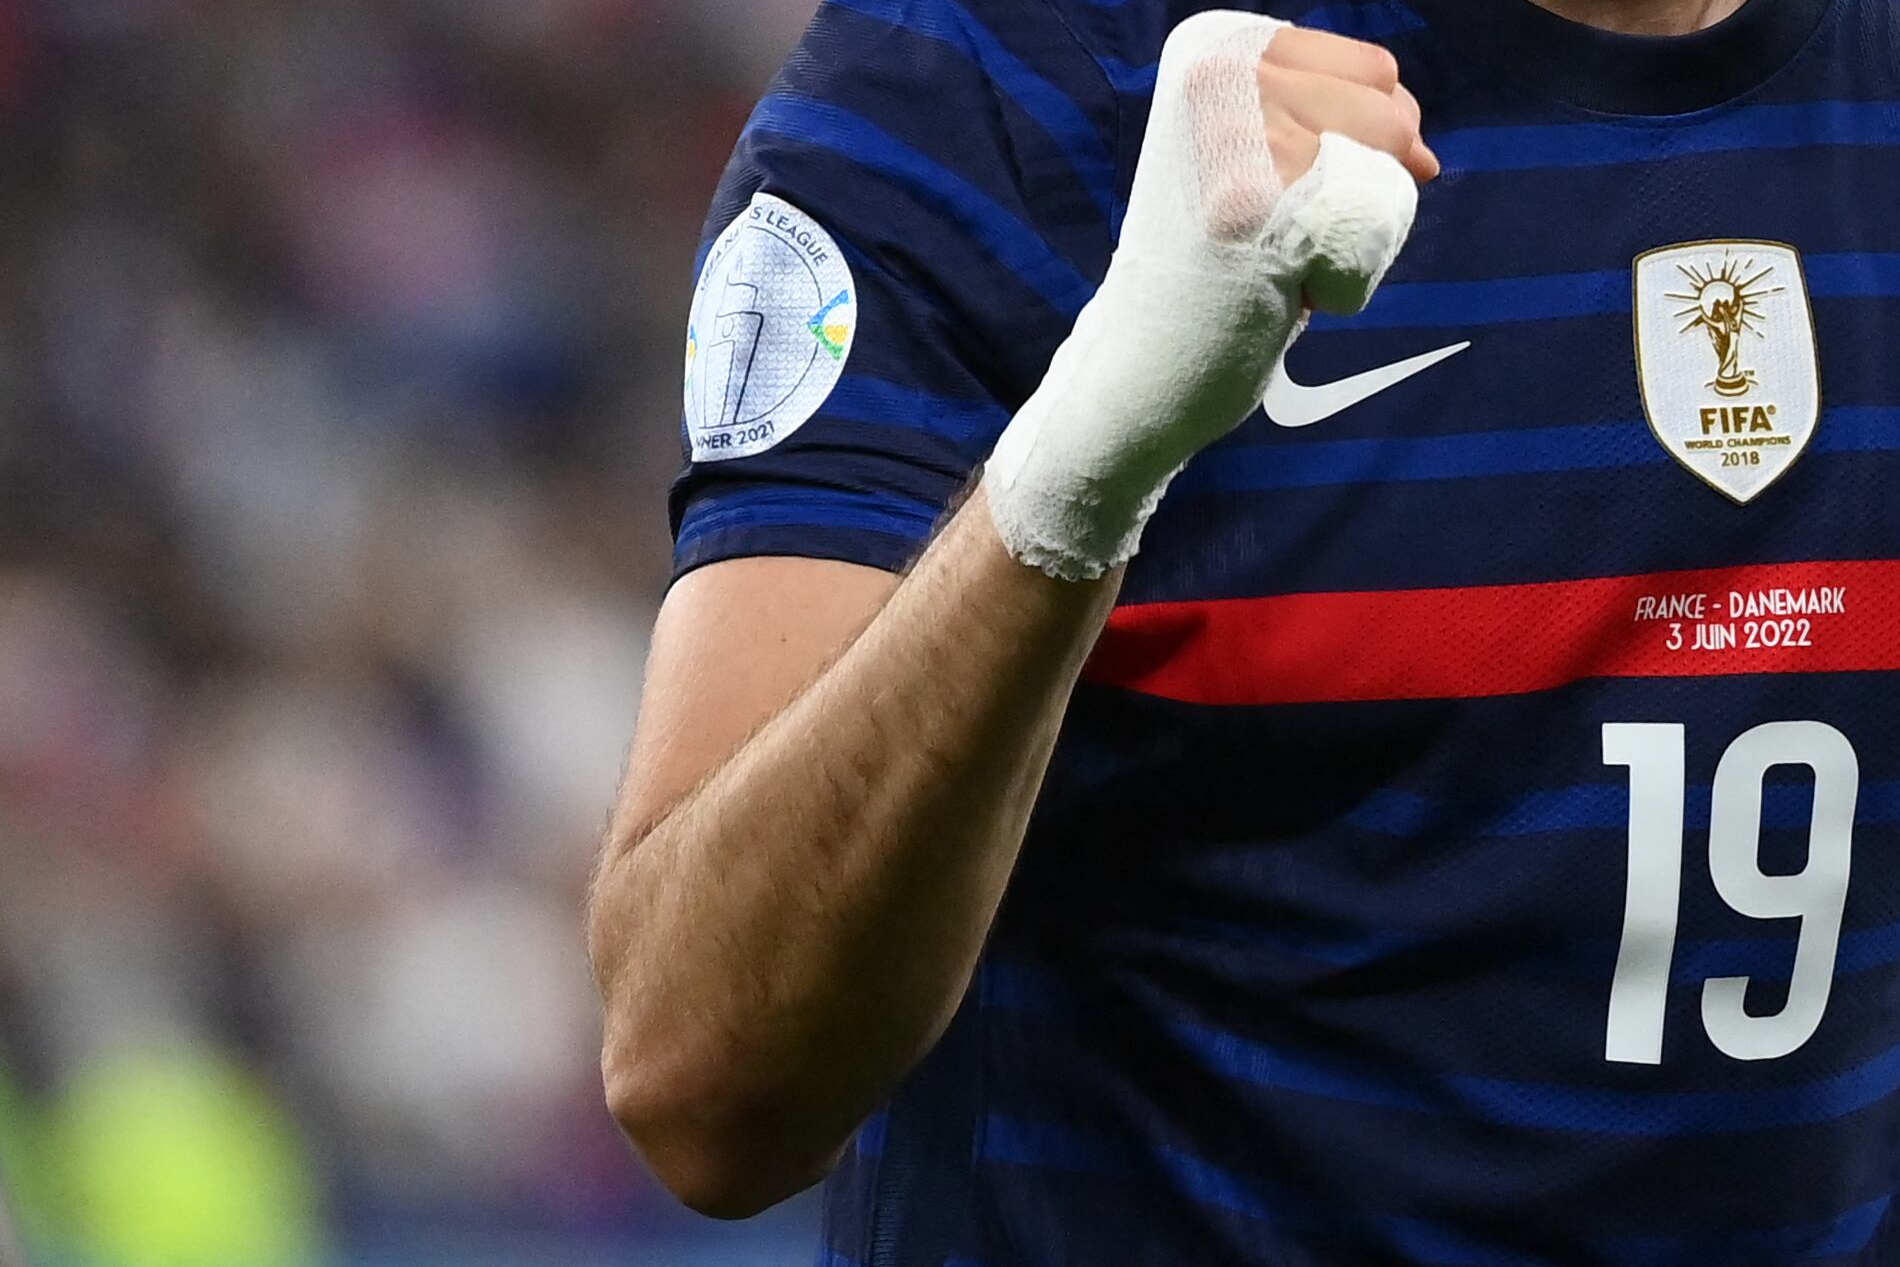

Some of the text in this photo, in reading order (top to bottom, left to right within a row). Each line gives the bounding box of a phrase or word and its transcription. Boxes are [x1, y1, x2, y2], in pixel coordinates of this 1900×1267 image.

[766, 209, 829, 267] LEAGUE
[736, 420, 776, 445] 2021
[1684, 435, 1792, 450] WORLD CHAMPIONS
[1720, 450, 1761, 467] 2018
[1634, 593, 1707, 622] FRANCE
[1729, 586, 1847, 619] DANEMARK
[1665, 618, 1813, 651] 3 JUIN 2022
[1602, 719, 1860, 1066] 19
